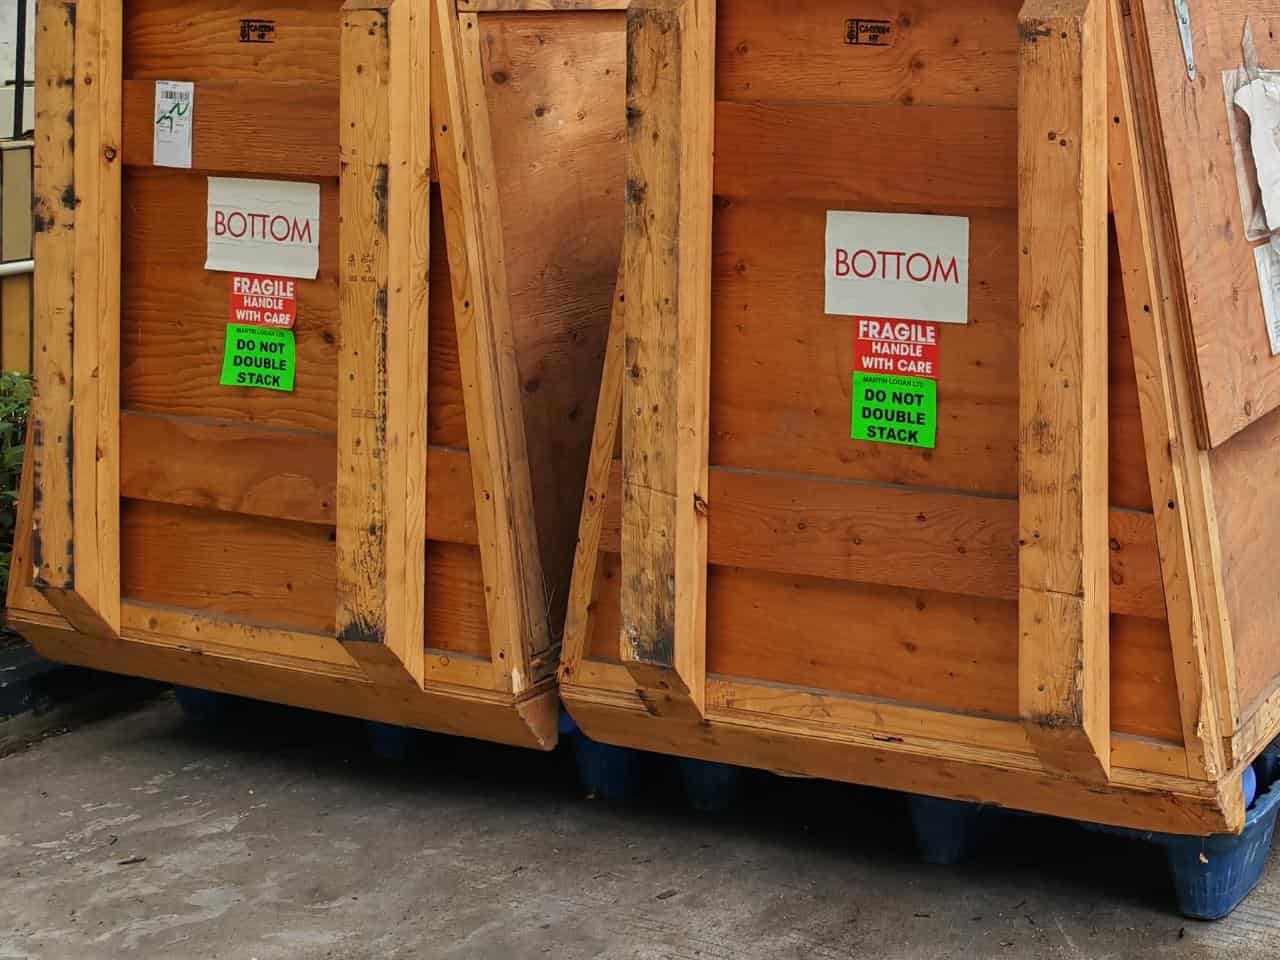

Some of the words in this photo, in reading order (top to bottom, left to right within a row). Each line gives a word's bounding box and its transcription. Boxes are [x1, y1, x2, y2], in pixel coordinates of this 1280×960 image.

[214, 210, 312, 243] BOTTOM
[835, 248, 959, 284] BOTTOM
[232, 277, 294, 297] FRAGILE
[243, 295, 285, 310] HANDLE
[235, 309, 261, 322] WITH
[263, 311, 291, 325] CARE
[858, 319, 936, 343] FRAGILE
[236, 339, 256, 351] DO
[259, 341, 285, 354] NOT
[871, 341, 923, 357] HANDLE
[233, 355, 287, 371] DOUBLE
[861, 356, 894, 371] WITH
[897, 359, 932, 374] CARE
[236, 372, 281, 387] STACK
[864, 388, 886, 403] DO
[892, 391, 925, 407] NOT
[861, 406, 926, 426] DOUBLE
[867, 425, 919, 443] STACK
